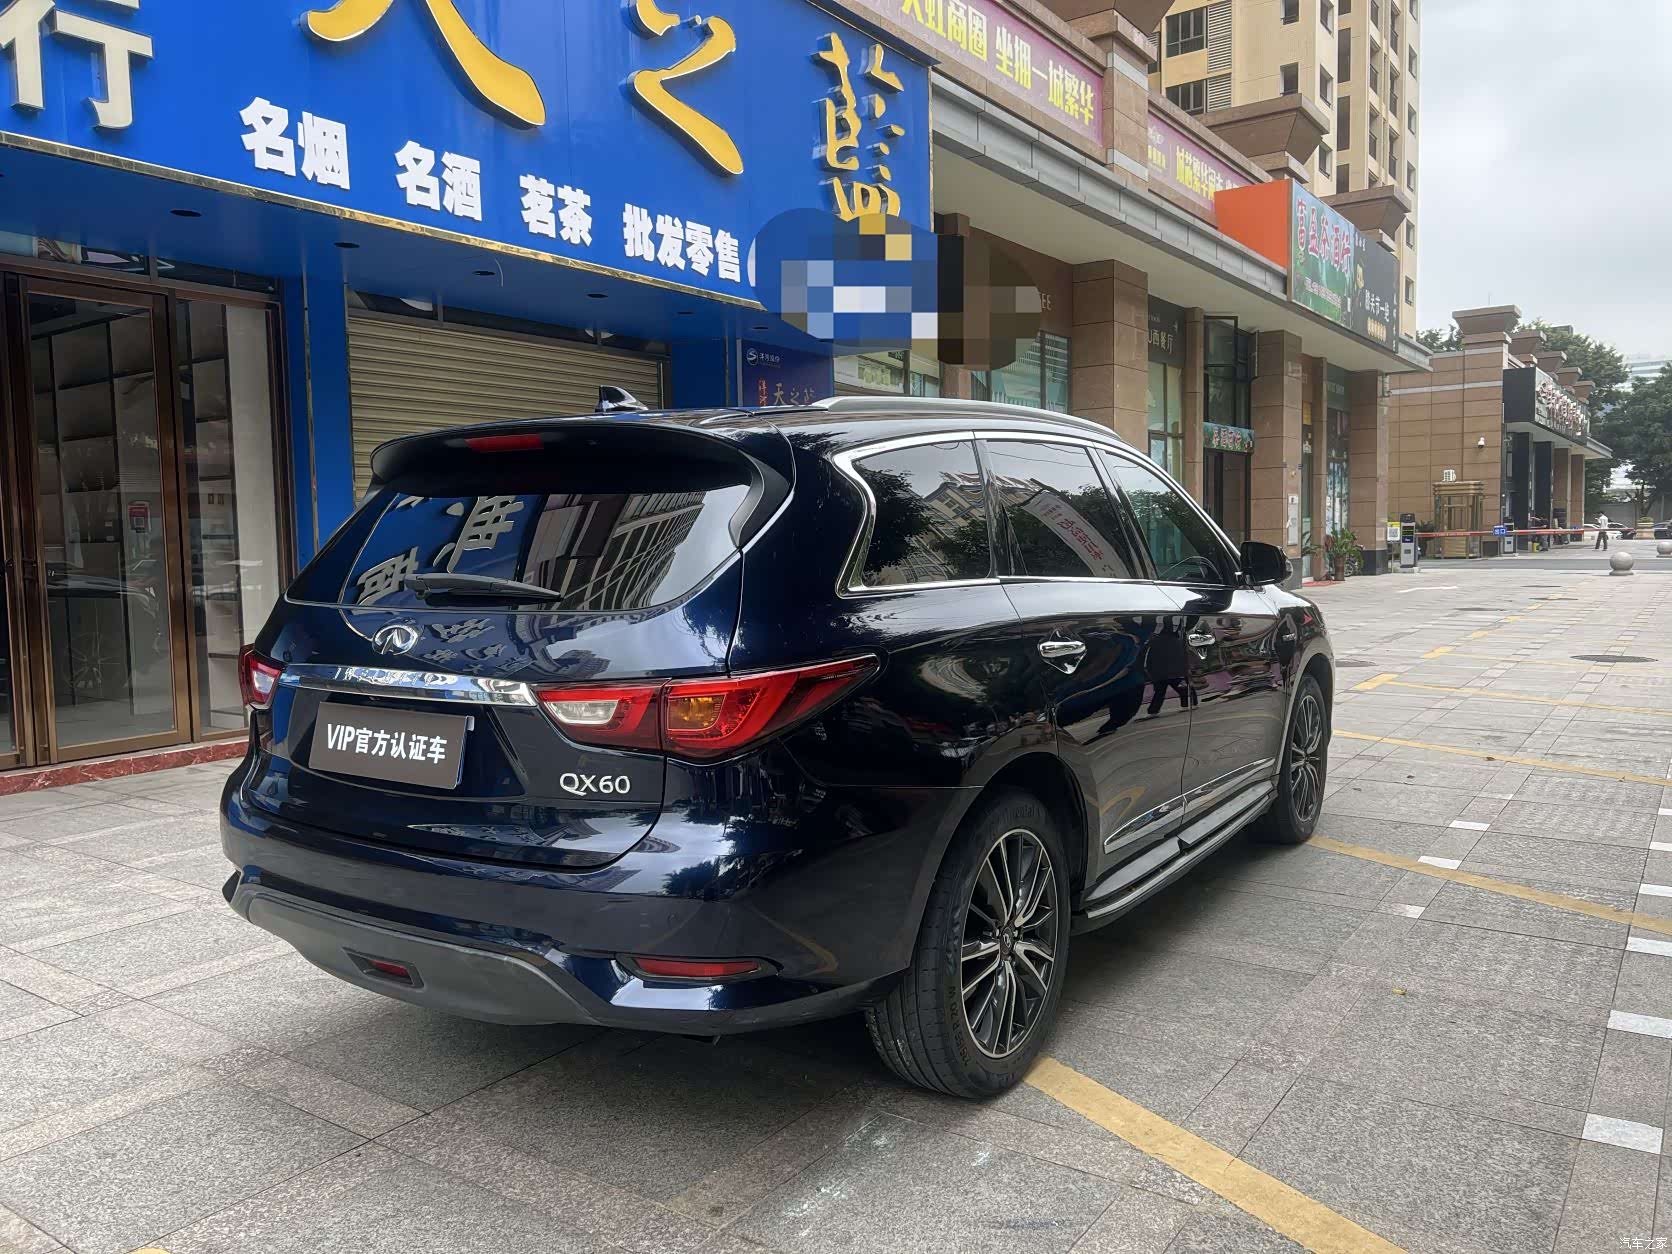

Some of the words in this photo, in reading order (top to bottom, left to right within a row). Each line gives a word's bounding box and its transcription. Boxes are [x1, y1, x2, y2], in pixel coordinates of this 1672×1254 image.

[995, 26, 1094, 126] 坐拥一城繁华
[240, 97, 351, 190] 名烟
[395, 141, 482, 221] 名酒
[519, 174, 593, 247] 茗茶
[622, 202, 741, 283] 批发零售
[327, 723, 448, 764] VIP官方认证车
[560, 773, 631, 796] QX60
